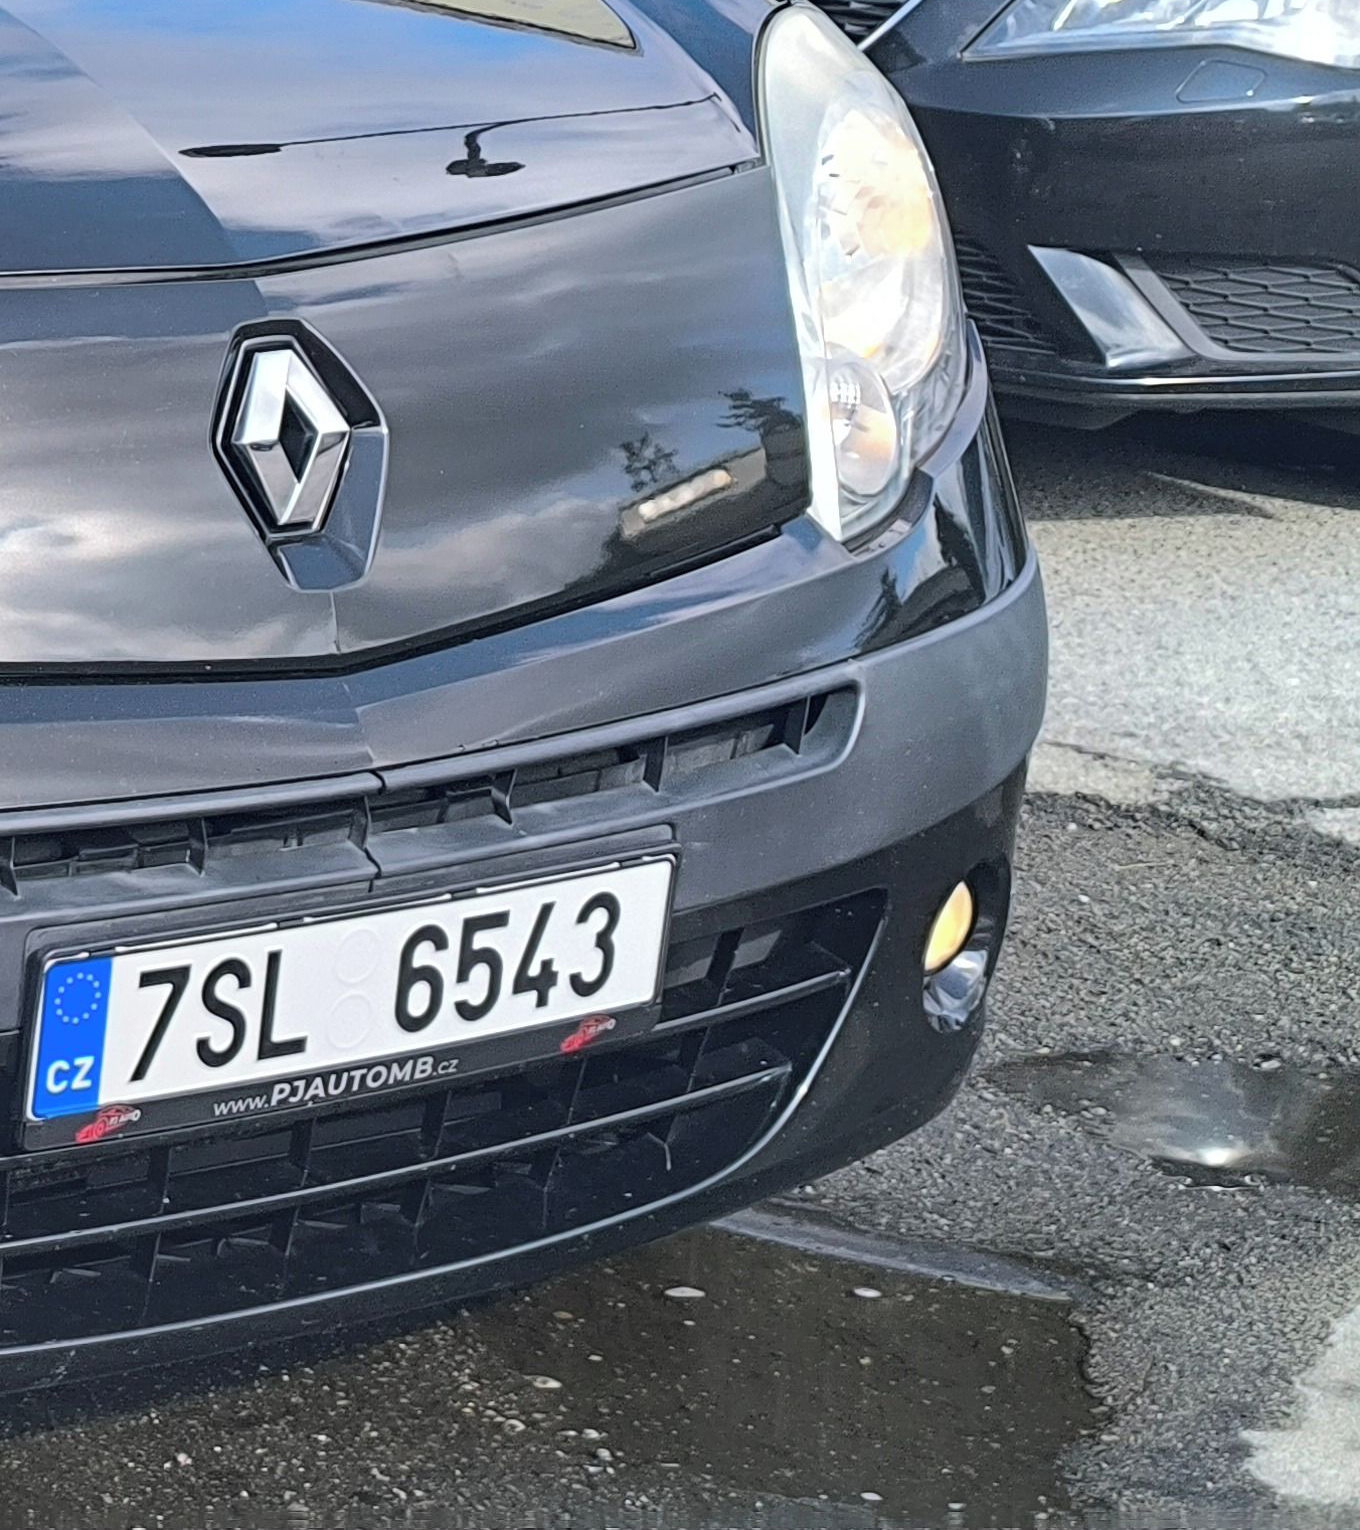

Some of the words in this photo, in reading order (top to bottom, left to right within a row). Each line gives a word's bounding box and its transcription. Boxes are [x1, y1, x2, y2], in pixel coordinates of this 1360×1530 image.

[128, 950, 308, 1082] 7SL
[394, 891, 622, 1033] 6543
[46, 1056, 93, 1094] CZ
